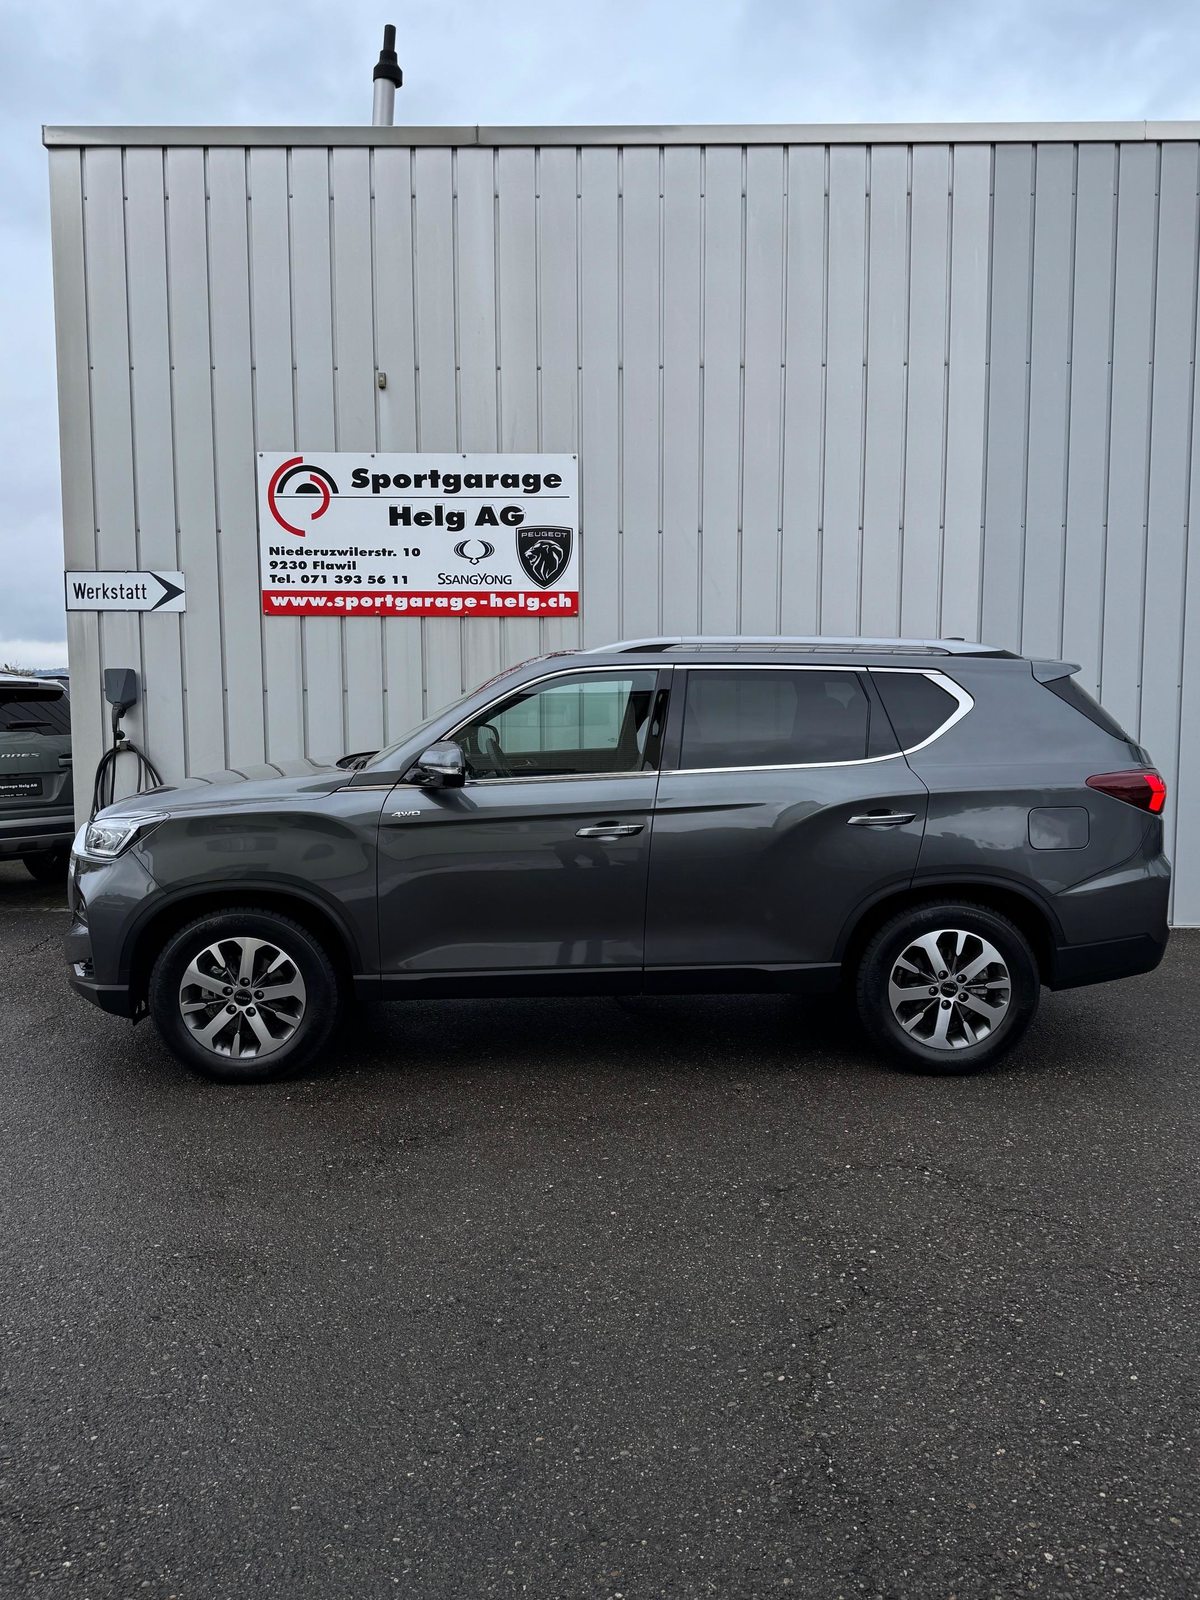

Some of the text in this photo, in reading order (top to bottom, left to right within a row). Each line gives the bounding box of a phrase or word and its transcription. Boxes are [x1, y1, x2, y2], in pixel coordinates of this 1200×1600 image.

[351, 468, 563, 494] Sportgarage
[389, 504, 526, 532] Helg AG
[269, 546, 421, 557] Niederuzwilerstr. 10
[269, 560, 357, 570] 9230 Flawil
[269, 574, 408, 585] Tel. 071 393 56 11
[73, 582, 147, 600] Werkstatt
[270, 593, 572, 611] www.sportgarage-helg.ch
